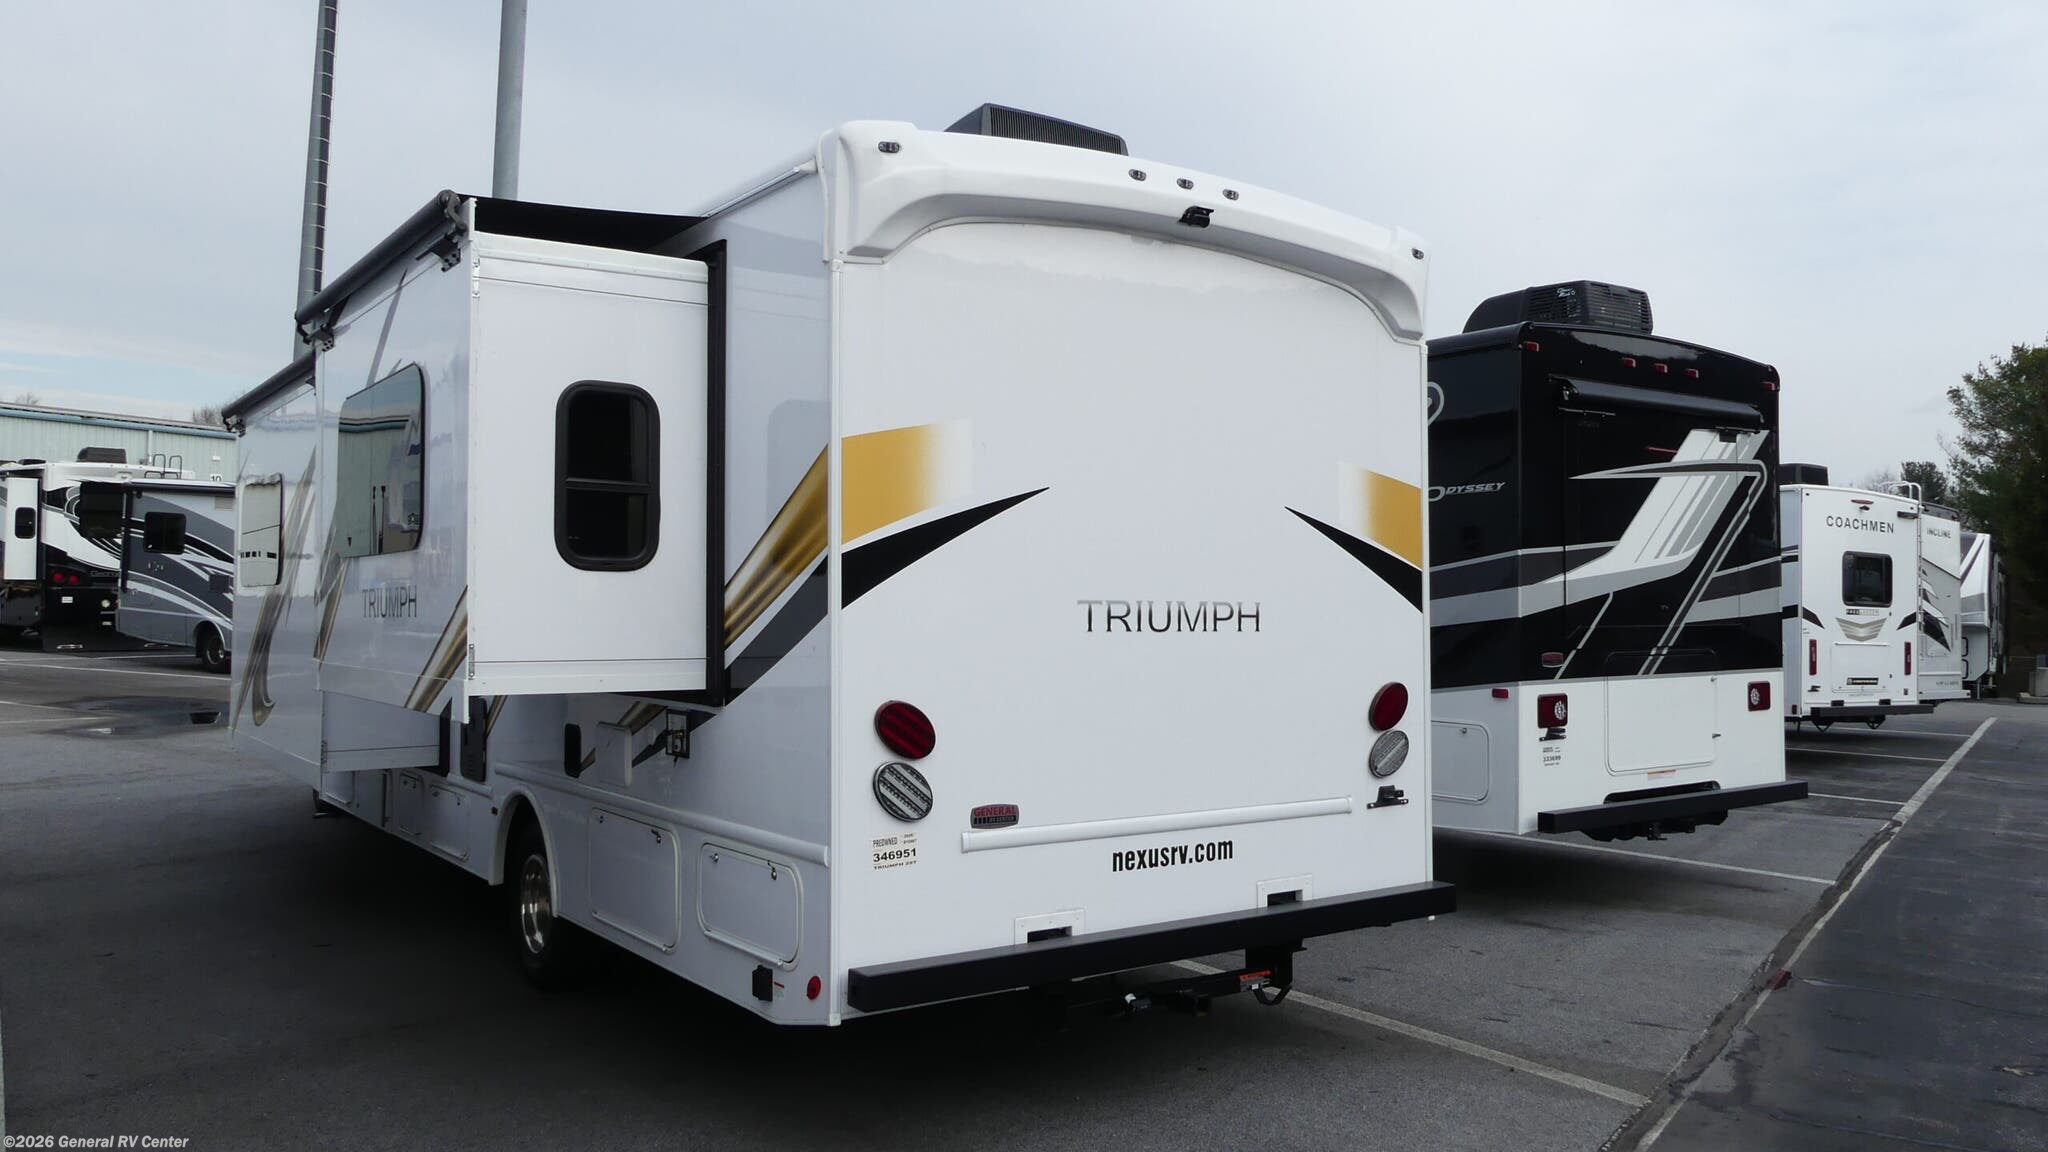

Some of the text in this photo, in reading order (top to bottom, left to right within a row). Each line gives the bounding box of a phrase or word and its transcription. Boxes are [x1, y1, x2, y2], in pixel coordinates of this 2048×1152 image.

[1428, 481, 1506, 503] ODYSSEY
[1826, 515, 1894, 533] COACHMEN
[1926, 528, 1952, 539] INCLINE
[361, 584, 417, 618] TRIUMPH
[1077, 600, 1261, 632] TRIUMPH
[973, 805, 1017, 817] GENERAL
[873, 847, 916, 863] 346951
[1112, 840, 1233, 872] nexusrv.com
[873, 862, 904, 870] TRIUMPH
